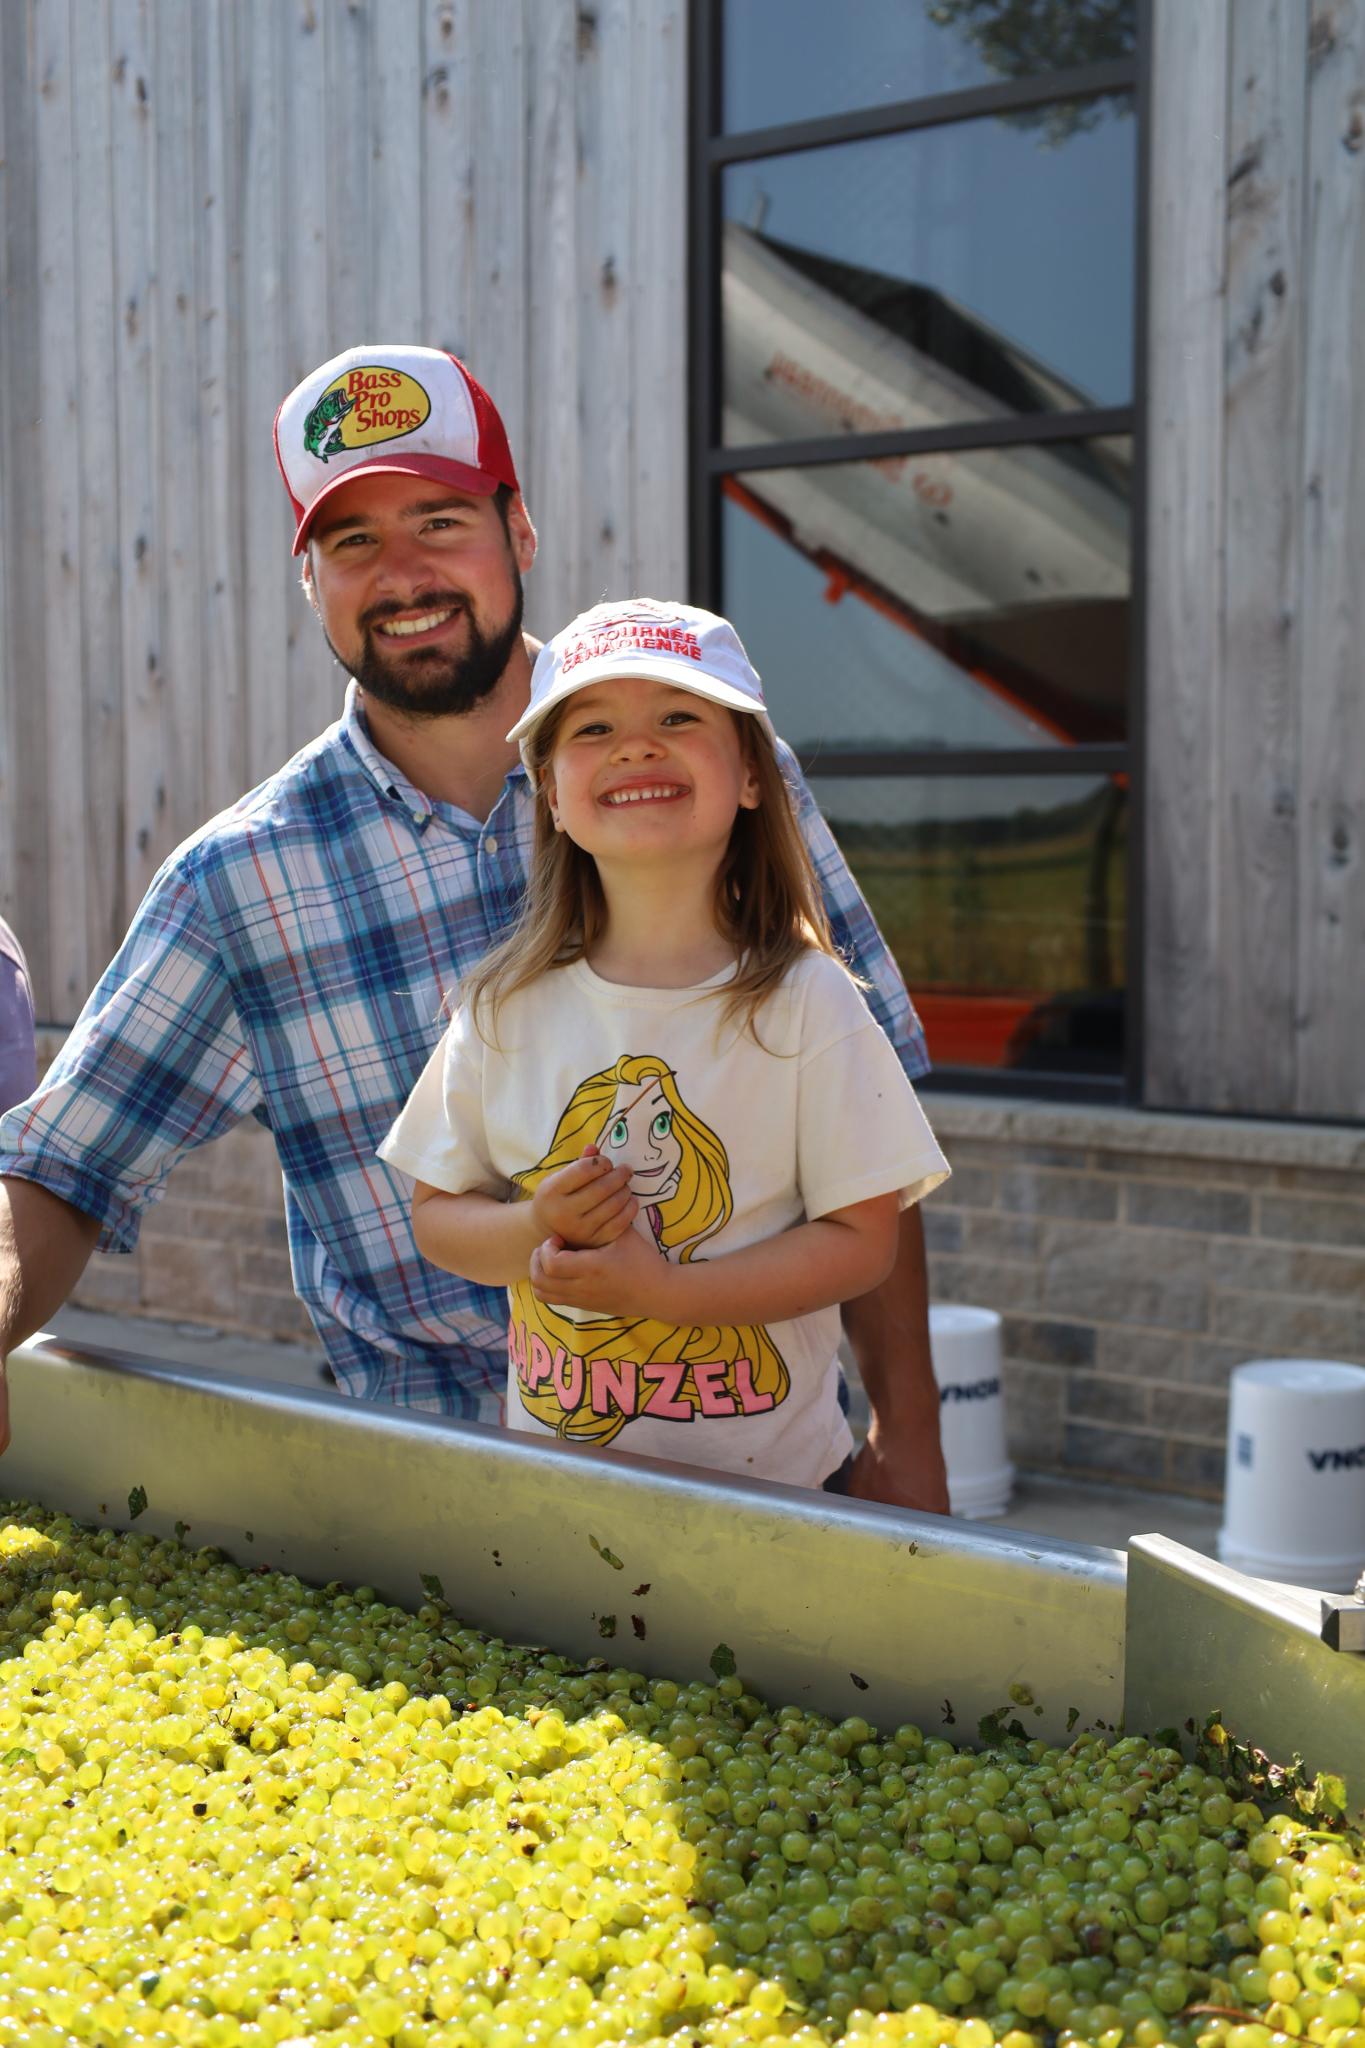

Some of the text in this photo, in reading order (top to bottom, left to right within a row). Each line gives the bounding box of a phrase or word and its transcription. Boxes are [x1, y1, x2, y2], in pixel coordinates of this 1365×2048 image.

[347, 370, 402, 395] Bass
[354, 390, 391, 412] Pro
[355, 408, 421, 433] Shops
[562, 638, 702, 674] CANADIENNE
[564, 640, 587, 659] LA
